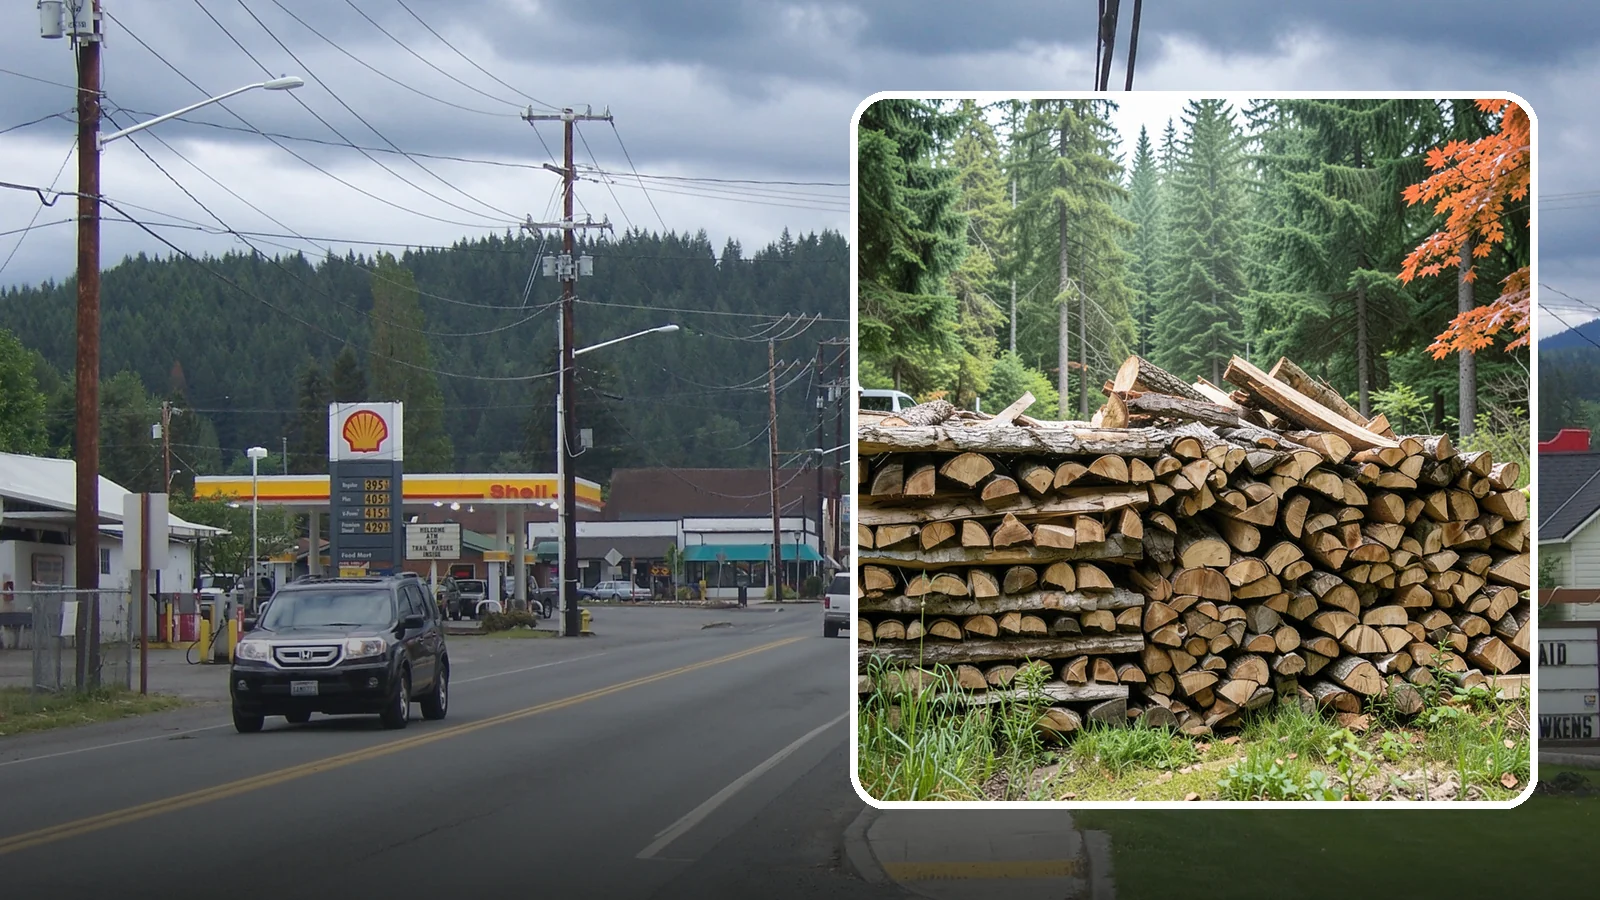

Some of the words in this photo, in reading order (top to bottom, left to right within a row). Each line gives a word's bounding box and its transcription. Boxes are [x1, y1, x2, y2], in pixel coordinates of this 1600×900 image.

[366, 480, 383, 490] 395
[490, 484, 547, 499] Shell
[366, 494, 383, 504] 405
[366, 508, 383, 518] 415
[366, 522, 383, 533] 429
